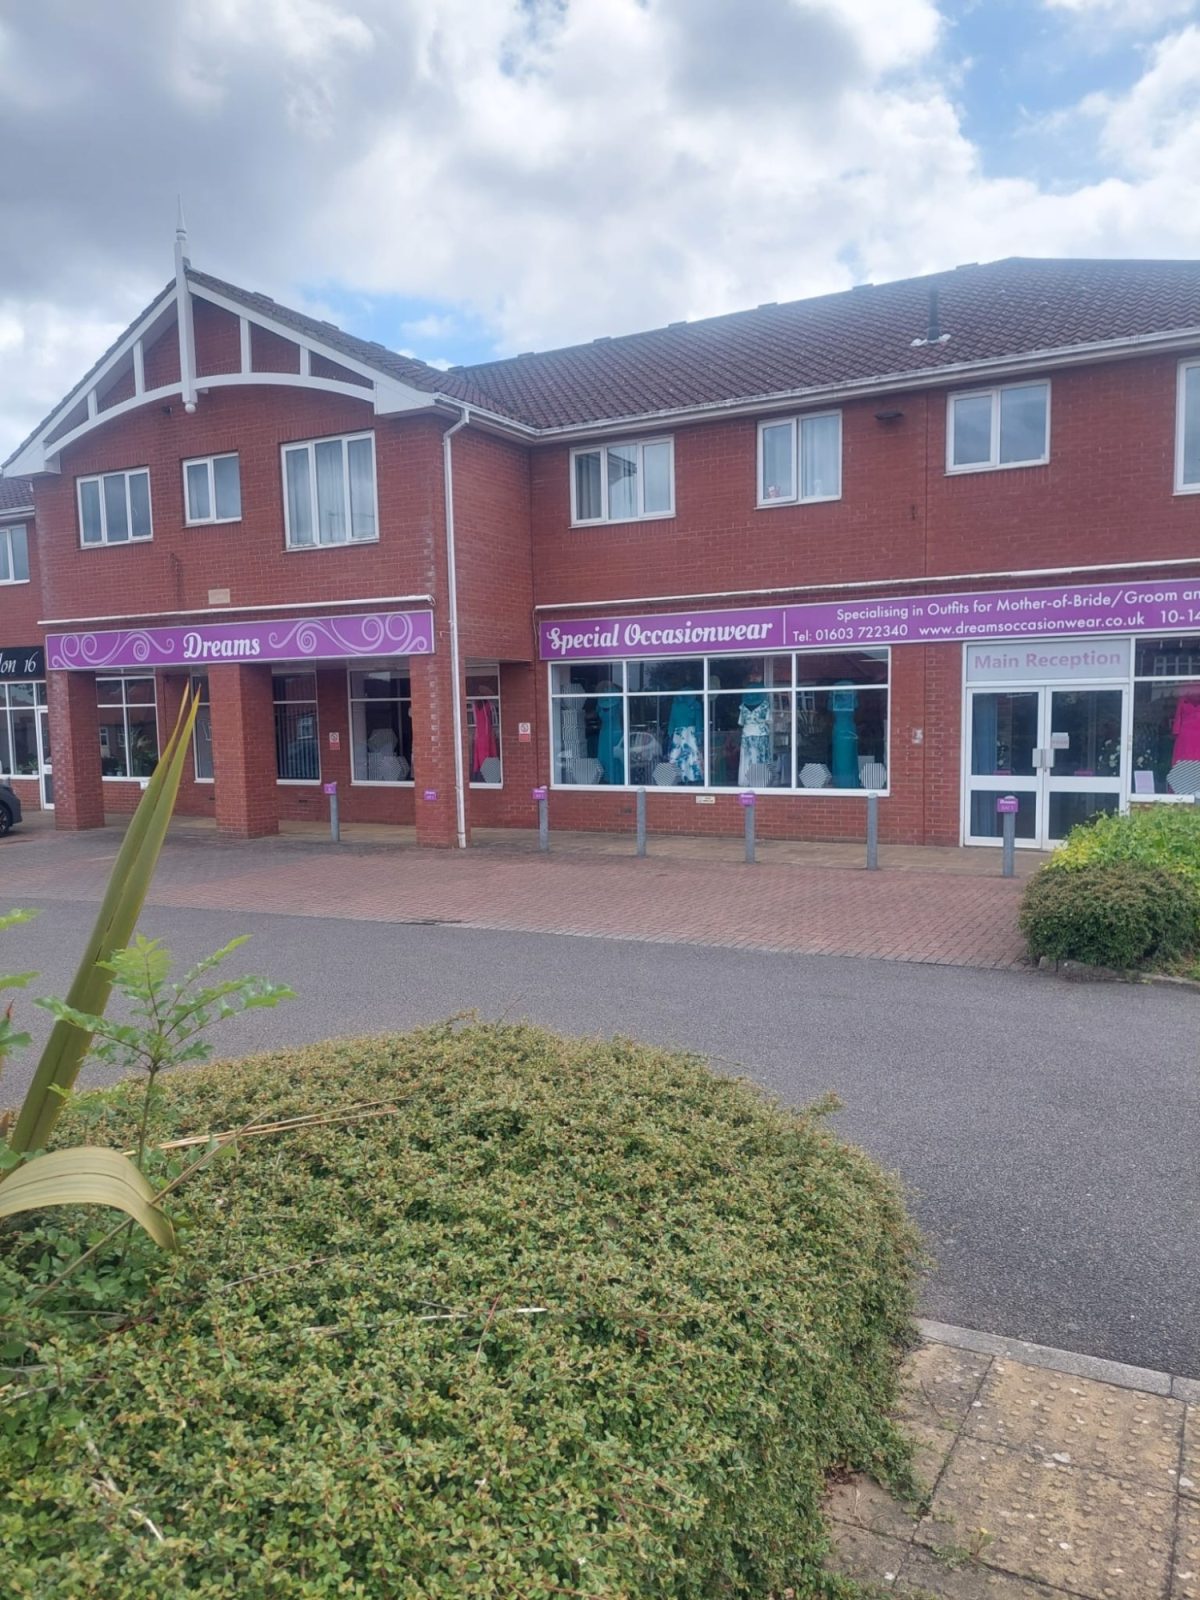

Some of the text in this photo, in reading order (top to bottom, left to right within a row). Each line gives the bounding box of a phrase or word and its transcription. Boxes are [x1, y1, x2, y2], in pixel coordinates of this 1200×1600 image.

[836, 606, 908, 622] Specialising
[912, 605, 924, 616] in
[927, 600, 970, 616] Outfits
[973, 600, 993, 613] for
[546, 620, 774, 654] Special Occasionwear
[793, 629, 812, 642] Tel:
[815, 627, 854, 641] 01603
[857, 624, 908, 639] 722340
[919, 612, 1145, 635] www.dreamsoccasionwear.co.uk
[183, 631, 261, 659] Dreams
[24, 651, 39, 673] 16
[974, 649, 1121, 670] Main Reception
